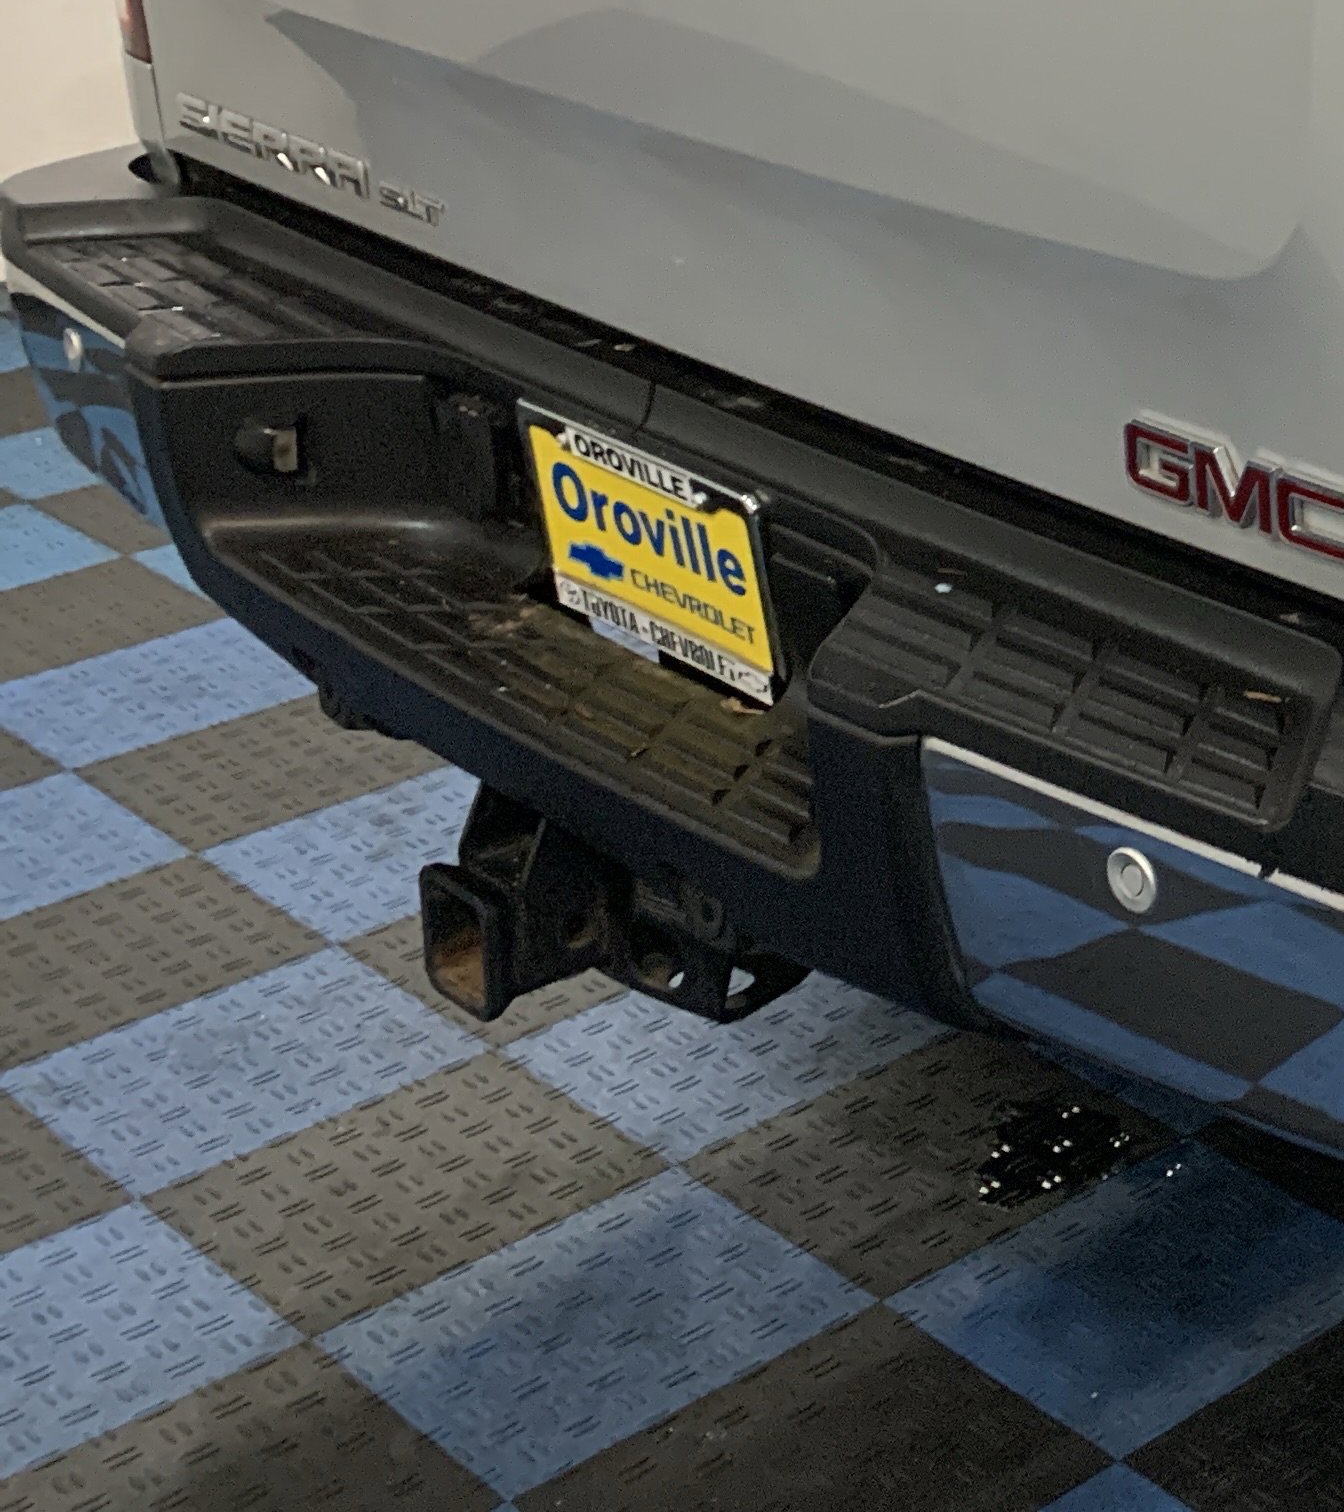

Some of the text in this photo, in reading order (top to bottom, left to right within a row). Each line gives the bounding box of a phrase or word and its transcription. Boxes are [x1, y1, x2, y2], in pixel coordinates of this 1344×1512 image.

[176, 92, 445, 227] SIERRA SLT
[571, 434, 690, 501] OROVILLE
[552, 461, 747, 596] Oroville
[630, 568, 755, 644] CHEVROLET
